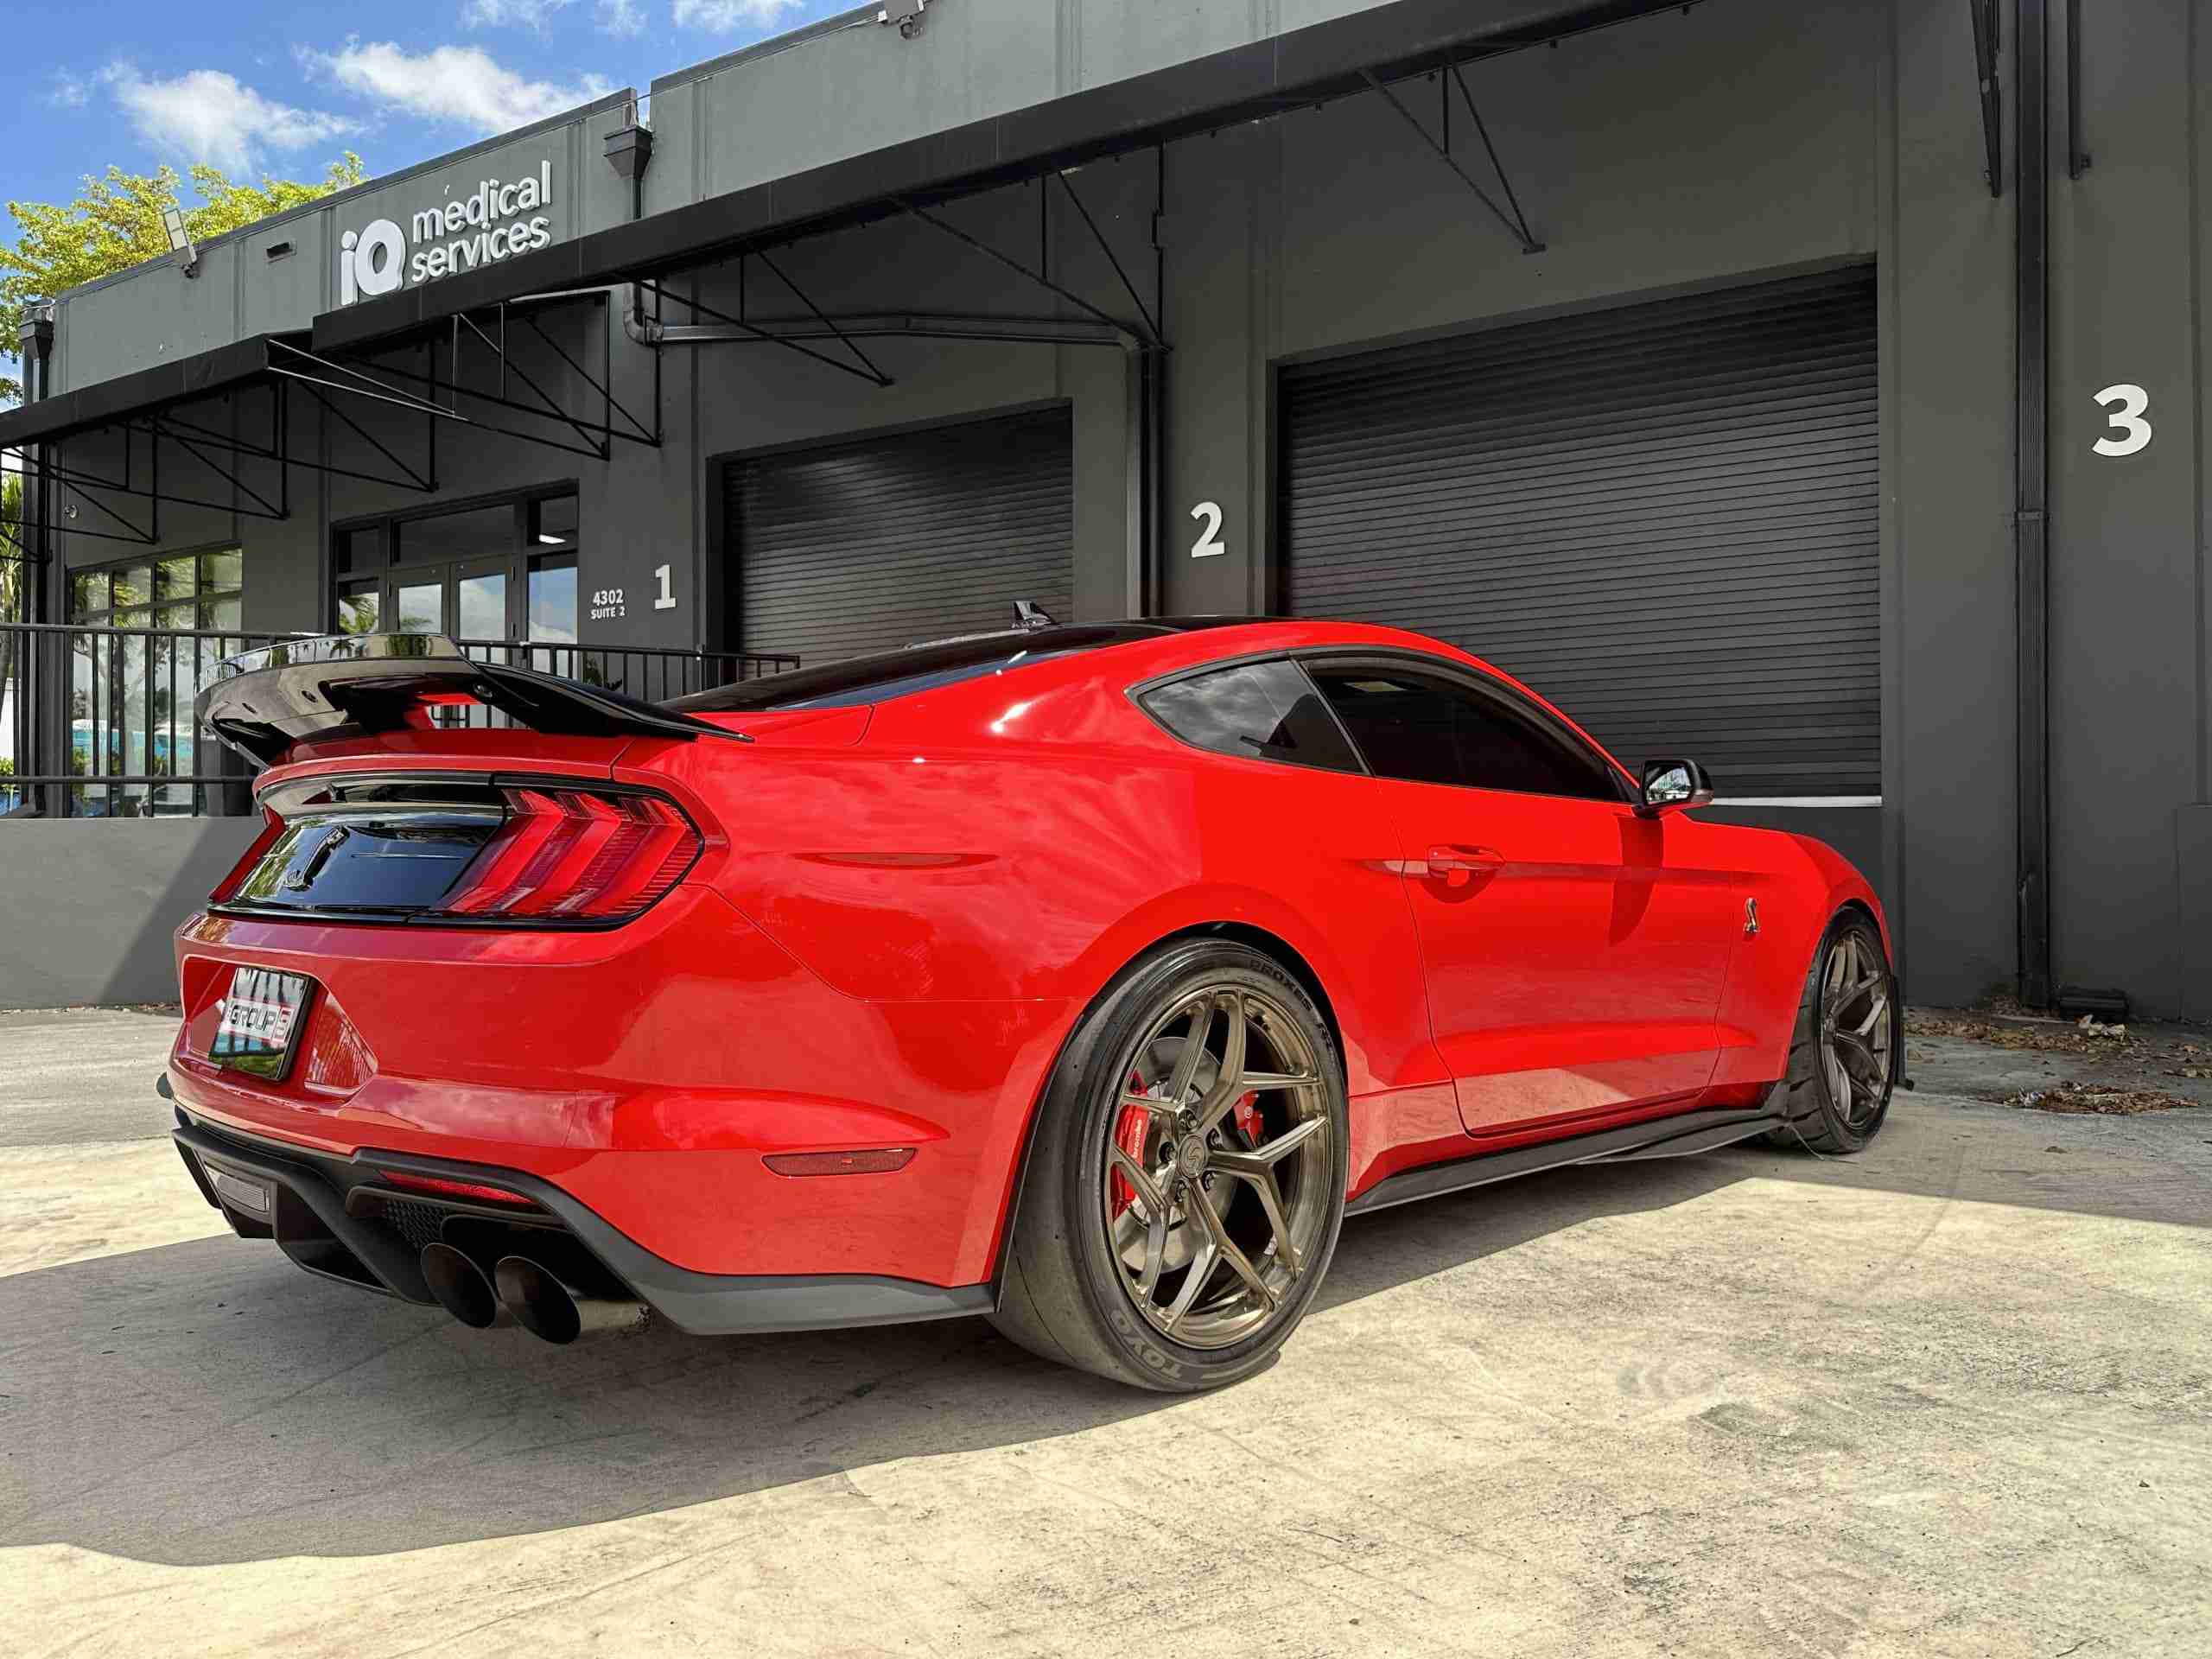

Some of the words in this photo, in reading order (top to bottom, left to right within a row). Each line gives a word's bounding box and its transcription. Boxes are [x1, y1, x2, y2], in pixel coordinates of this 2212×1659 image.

[412, 159, 552, 245] medical
[410, 216, 552, 283] services
[2092, 383, 2152, 457] 3
[1190, 501, 1225, 559] 2
[590, 607, 616, 620] SUITE
[619, 606, 626, 617] 2
[592, 588, 624, 607] 4302
[654, 563, 677, 610] 1
